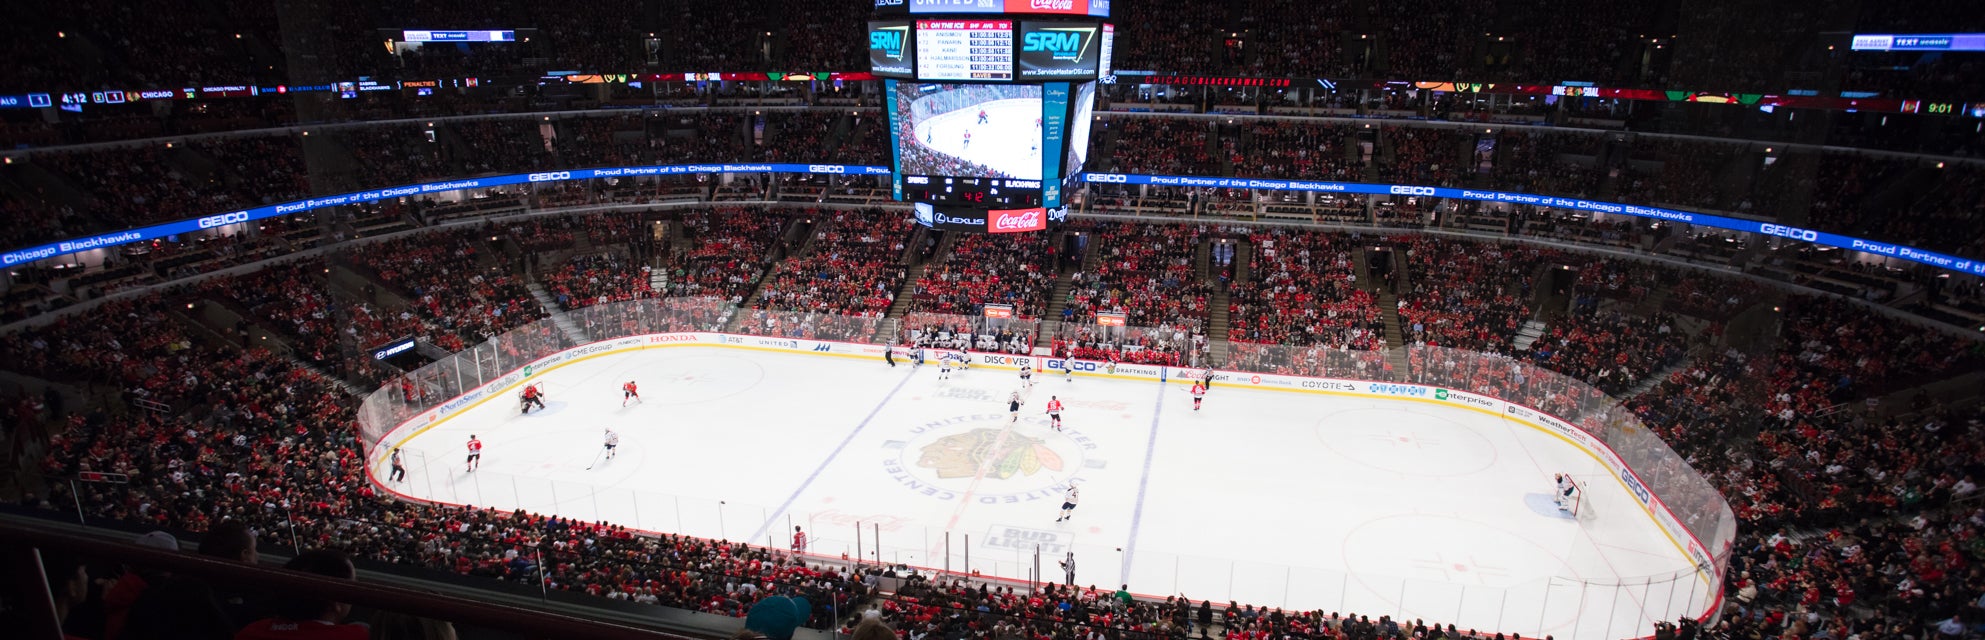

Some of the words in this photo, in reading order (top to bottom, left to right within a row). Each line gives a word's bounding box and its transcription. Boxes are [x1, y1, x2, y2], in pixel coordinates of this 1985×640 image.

[870, 31, 900, 50] SRM
[1023, 32, 1080, 51] SRM
[1896, 38, 1918, 46] TEXT
[61, 93, 87, 104] 4:12
[141, 91, 173, 99] CHICAGO
[1552, 86, 1566, 96] ONE
[1583, 87, 1599, 97] GOAL
[1928, 102, 1952, 113] 9:01
[528, 171, 570, 181] GEICO
[594, 168, 621, 176] Proud
[624, 167, 658, 175] Partner
[688, 164, 722, 173] Chicago
[809, 165, 844, 174] GEICO
[1086, 173, 1127, 182] GEICO
[1150, 175, 1178, 184] Proud
[1181, 177, 1217, 186] Partner
[1219, 178, 1229, 186] of
[1231, 179, 1246, 187] the
[1250, 179, 1286, 189] Chicago
[1289, 181, 1345, 190] Blackhawks
[276, 200, 306, 213] Proud
[308, 196, 347, 209] Partner
[349, 193, 361, 202] of
[363, 191, 379, 200] the
[382, 185, 420, 198] Chicago
[422, 180, 479, 191] Blackhawks
[1390, 185, 1434, 196] GEICO
[1463, 190, 1495, 200] Proud
[1498, 193, 1540, 204] Partner
[1542, 196, 1553, 205] of
[1556, 198, 1574, 207] the
[1577, 200, 1622, 213] Chicago
[1625, 205, 1693, 221] Blackhawks
[198, 211, 248, 229] GEICO
[946, 216, 985, 225] LEXUS
[996, 211, 1040, 229] Coca-Cola
[1759, 222, 1817, 241] GEICO
[3, 247, 57, 264] Chicago
[59, 231, 141, 253] Blackhawks
[1852, 240, 1897, 255] Proud
[1899, 247, 1951, 266] Partner
[1953, 258, 1971, 271] of
[650, 334, 698, 343] HONDA
[572, 346, 590, 358] CME
[591, 343, 613, 355] Group
[984, 355, 1030, 366] DISCOVER
[1047, 360, 1096, 371] GECO
[1116, 367, 1157, 376] DRAFTKINGS
[1302, 381, 1341, 390] COYOTE
[909, 413, 1003, 434] UNITED
[1538, 415, 1587, 441] WeatherTech
[883, 458, 954, 501] CENTER
[1621, 468, 1649, 504] GEICO
[1003, 528, 1058, 542] BUD
[988, 536, 1066, 553] LIGHT
